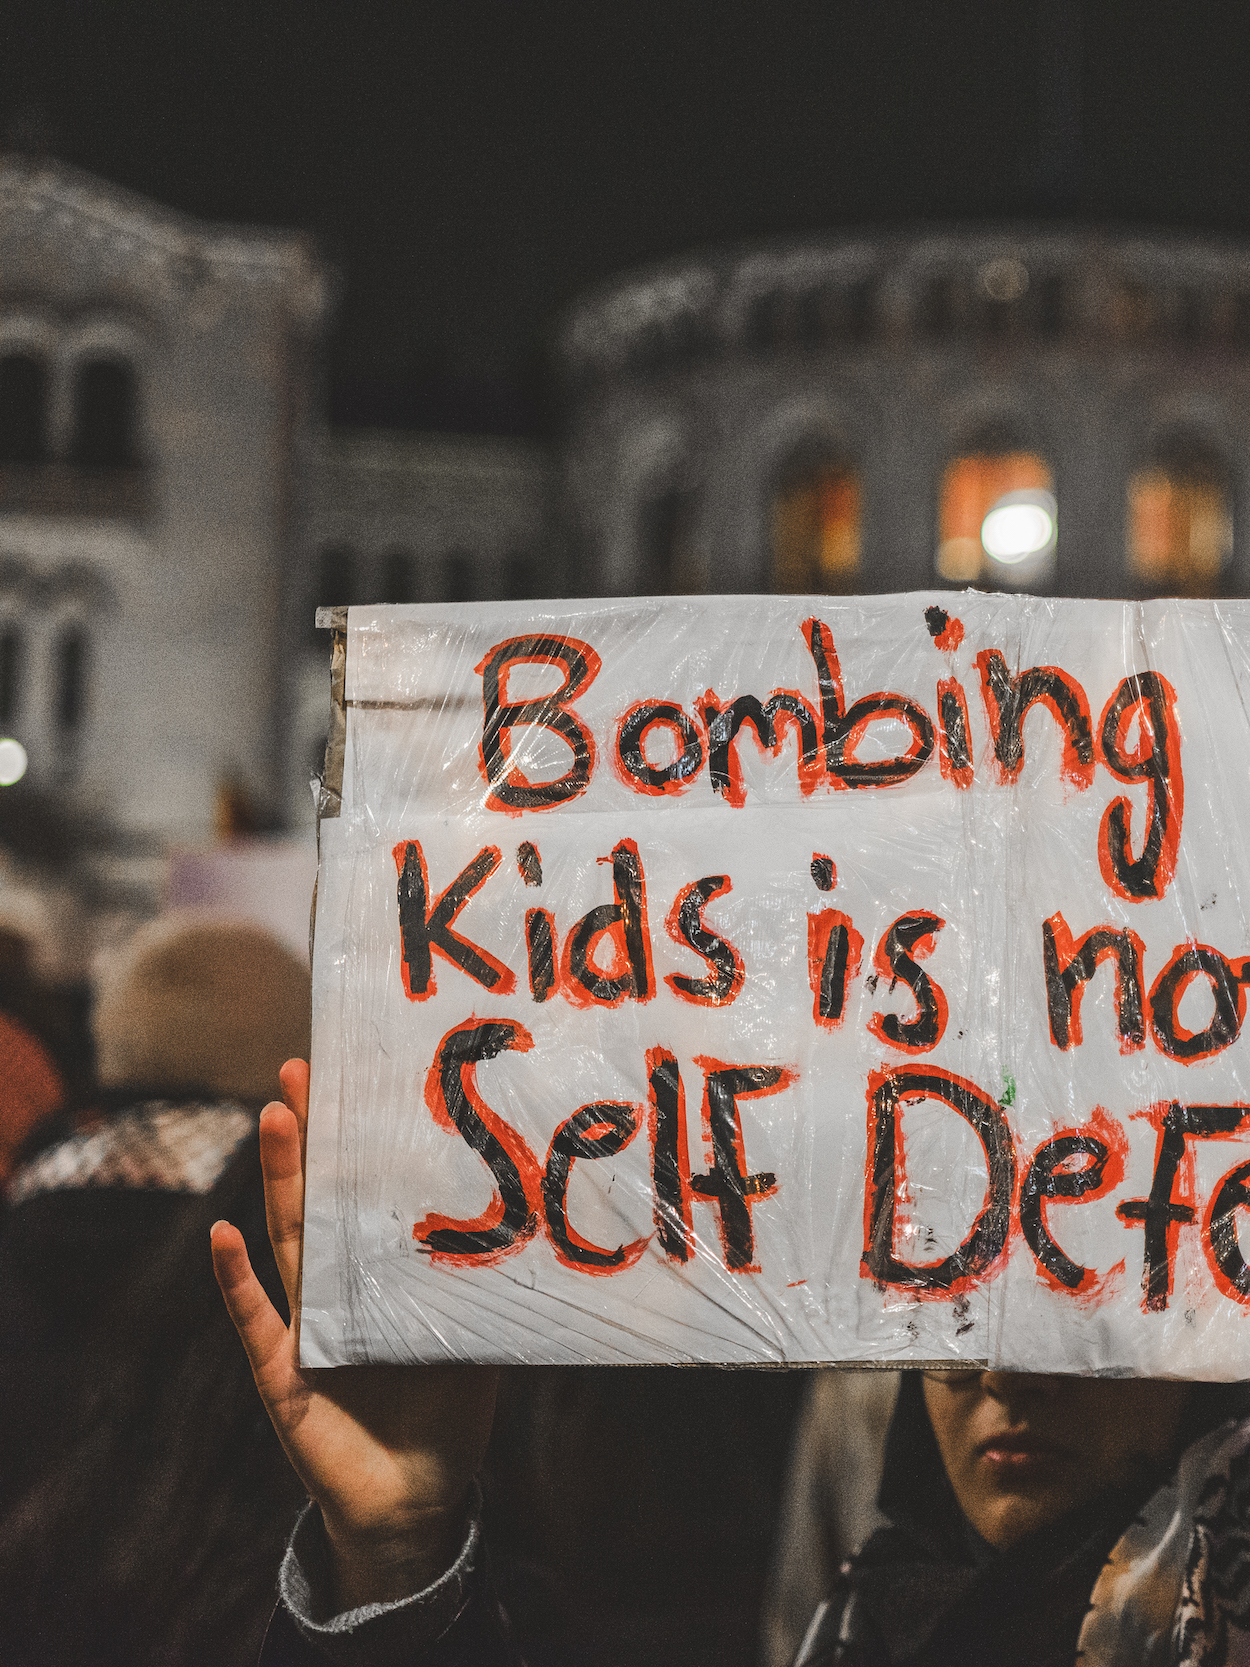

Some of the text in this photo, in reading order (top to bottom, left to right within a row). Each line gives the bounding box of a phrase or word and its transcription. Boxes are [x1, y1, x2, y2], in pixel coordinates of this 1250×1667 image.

[475, 606, 1184, 903] Bombing
[393, 838, 746, 1008] Kids
[807, 852, 949, 1054] is
